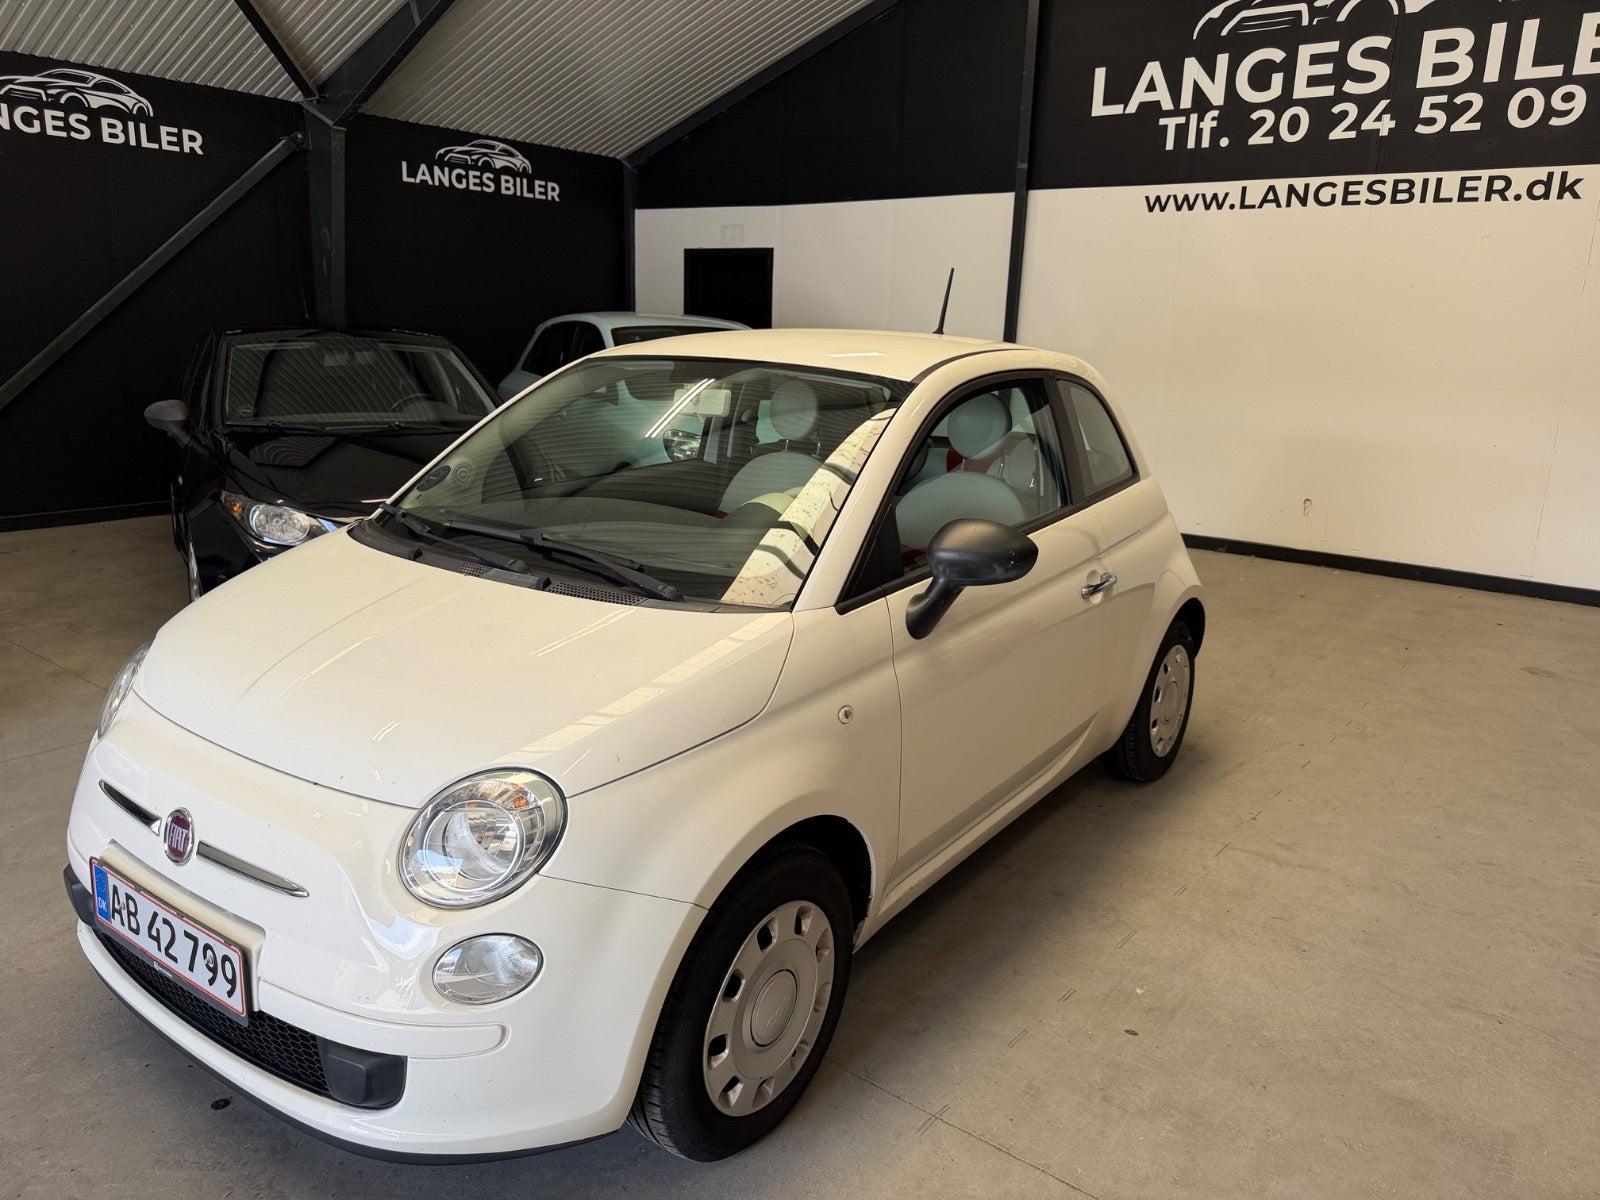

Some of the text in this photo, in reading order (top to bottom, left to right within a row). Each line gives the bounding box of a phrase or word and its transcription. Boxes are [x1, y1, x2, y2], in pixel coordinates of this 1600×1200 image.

[1091, 36, 1393, 117] LANGES
[100, 117, 204, 156] BILER
[1158, 84, 1588, 151] Tlf. 20 24 52 09
[401, 160, 561, 203] LANGES BILER
[1144, 170, 1584, 213] www.LANGESBILER.dk
[168, 822, 189, 852] FIAT
[111, 883, 141, 937] AB
